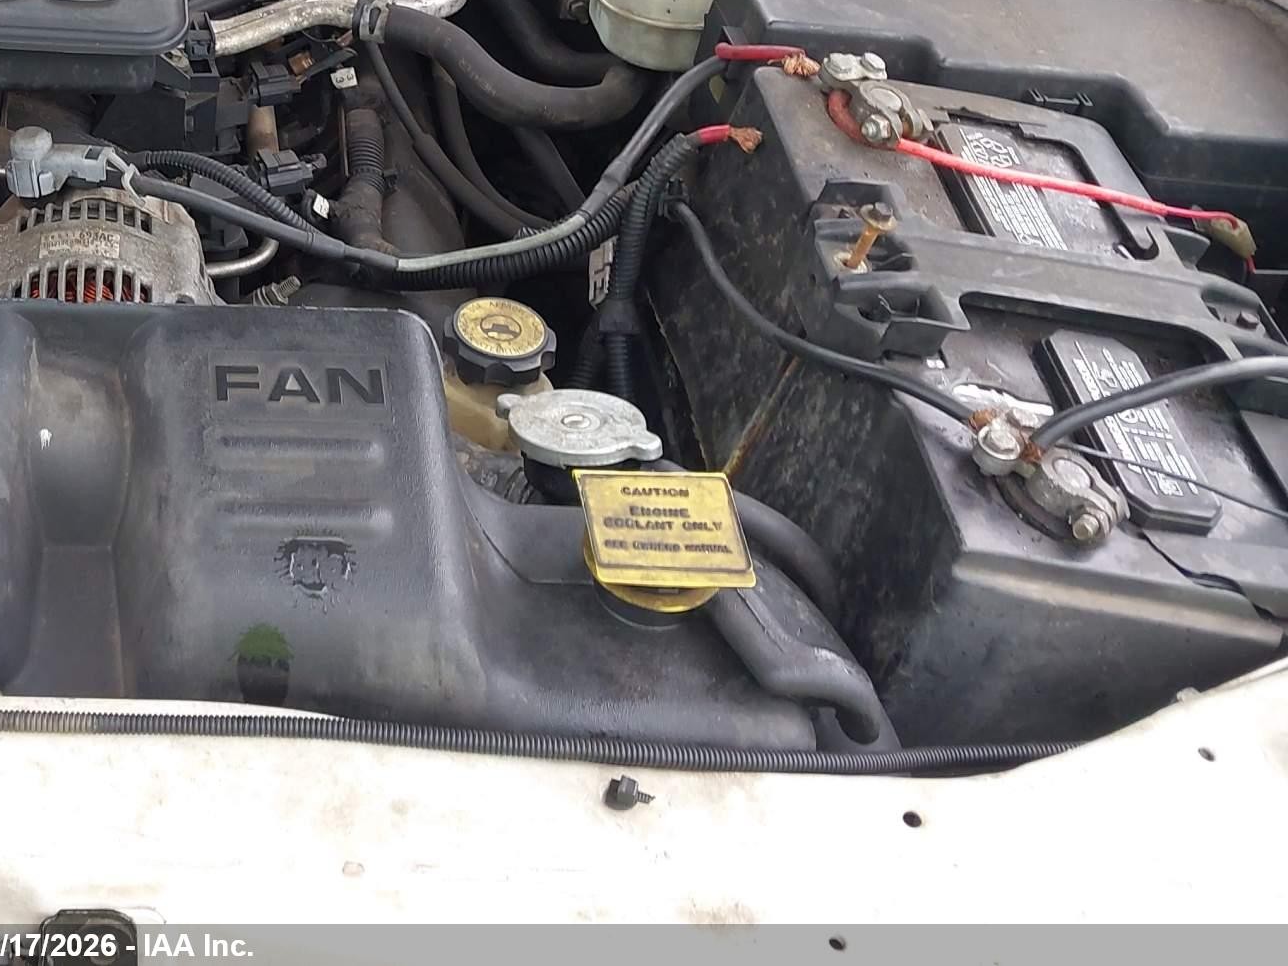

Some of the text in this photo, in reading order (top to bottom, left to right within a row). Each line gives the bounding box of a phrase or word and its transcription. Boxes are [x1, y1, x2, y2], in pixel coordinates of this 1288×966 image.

[214, 363, 386, 406] FAN
[620, 486, 690, 499] CAUTION
[629, 505, 691, 519] ENGINE
[603, 517, 723, 532] COOLANT ONLY
